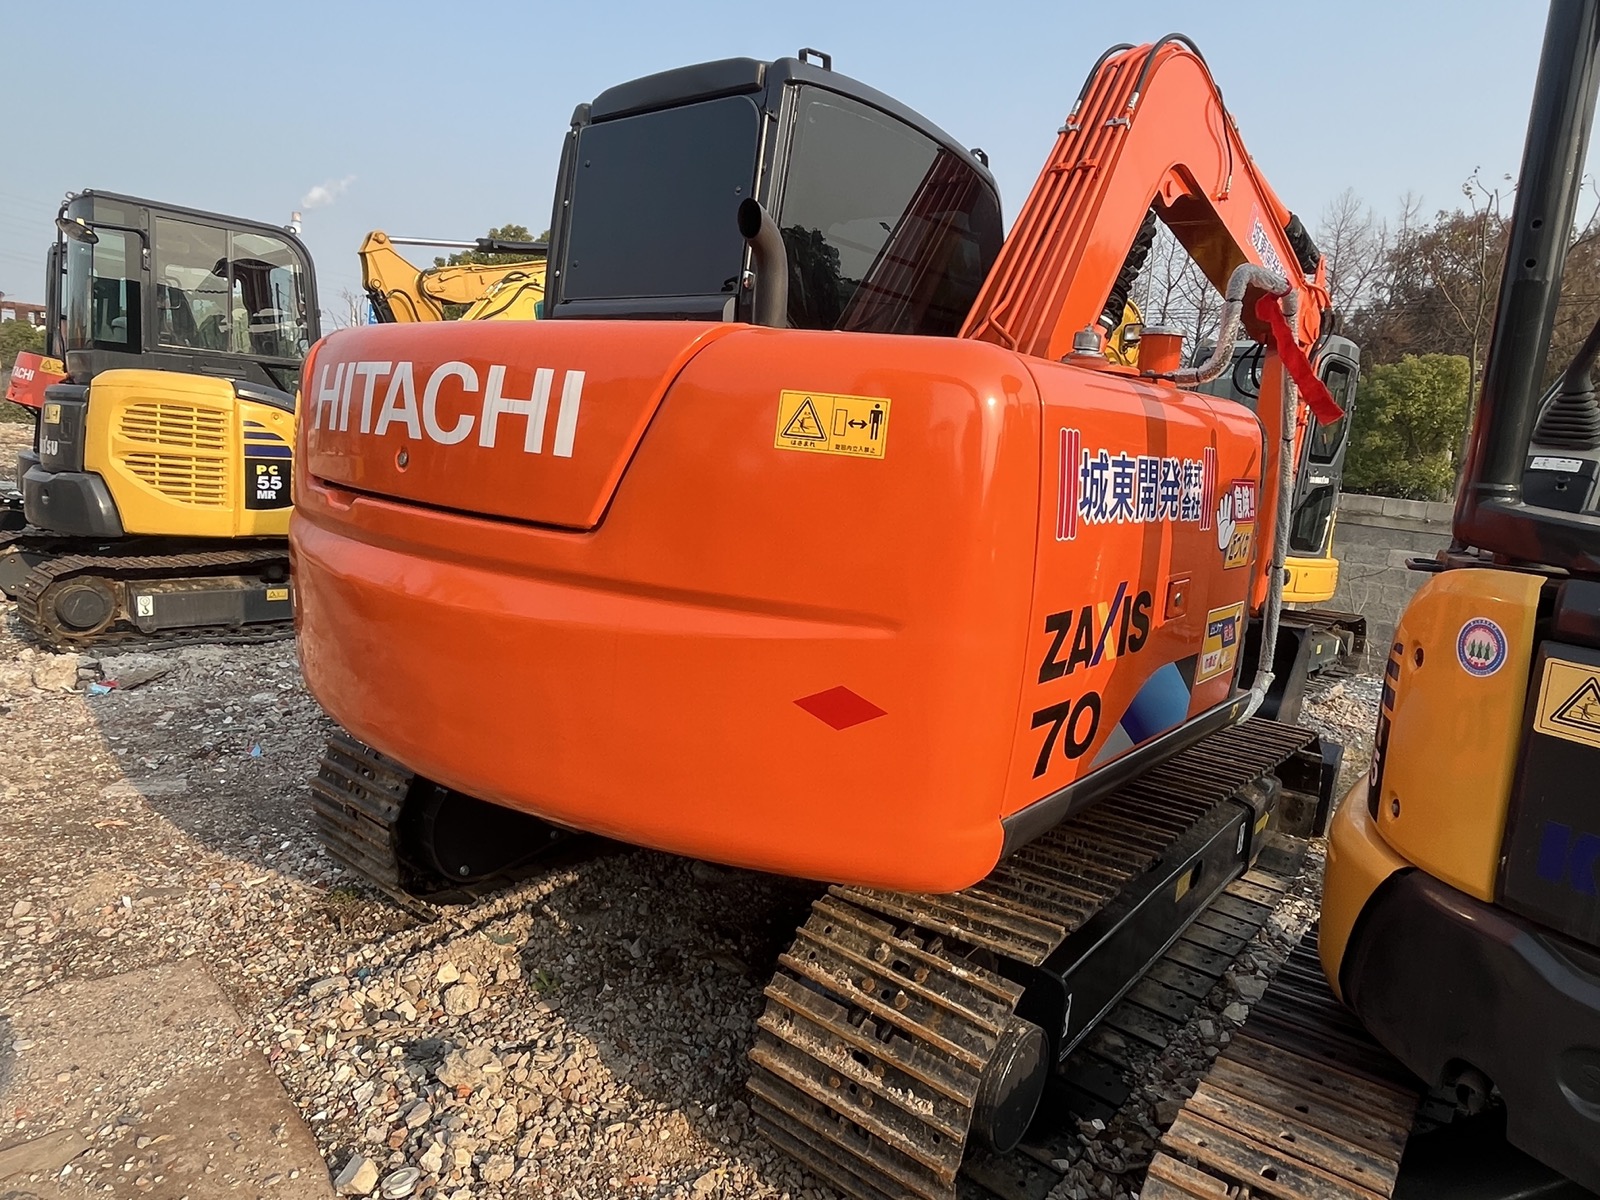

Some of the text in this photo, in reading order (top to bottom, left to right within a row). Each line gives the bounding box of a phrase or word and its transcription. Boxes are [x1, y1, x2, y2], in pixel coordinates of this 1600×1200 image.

[315, 361, 586, 458] HITACHI
[256, 464, 279, 475] PC
[256, 490, 277, 500] MR
[257, 475, 283, 490] 55
[1079, 451, 1181, 520] 城東開発
[1038, 581, 1152, 685] ZAXIS
[1031, 691, 1102, 779] 70
